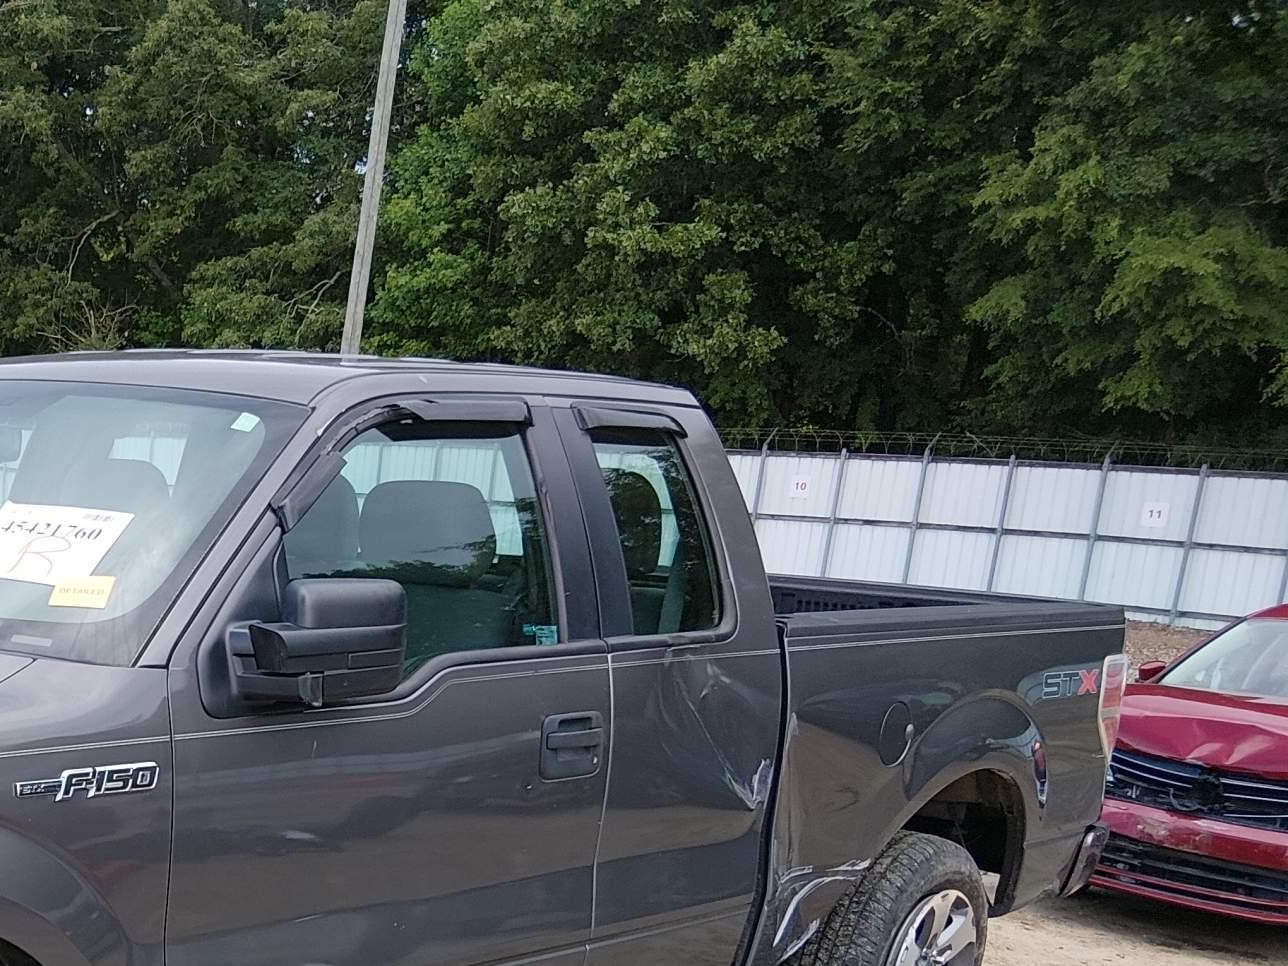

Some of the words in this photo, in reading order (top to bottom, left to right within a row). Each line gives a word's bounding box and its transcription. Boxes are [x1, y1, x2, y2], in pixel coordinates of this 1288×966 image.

[795, 482, 807, 491] 10
[1148, 509, 1162, 519] 11
[1, 520, 103, 541] 45421760
[1042, 669, 1099, 699] STX
